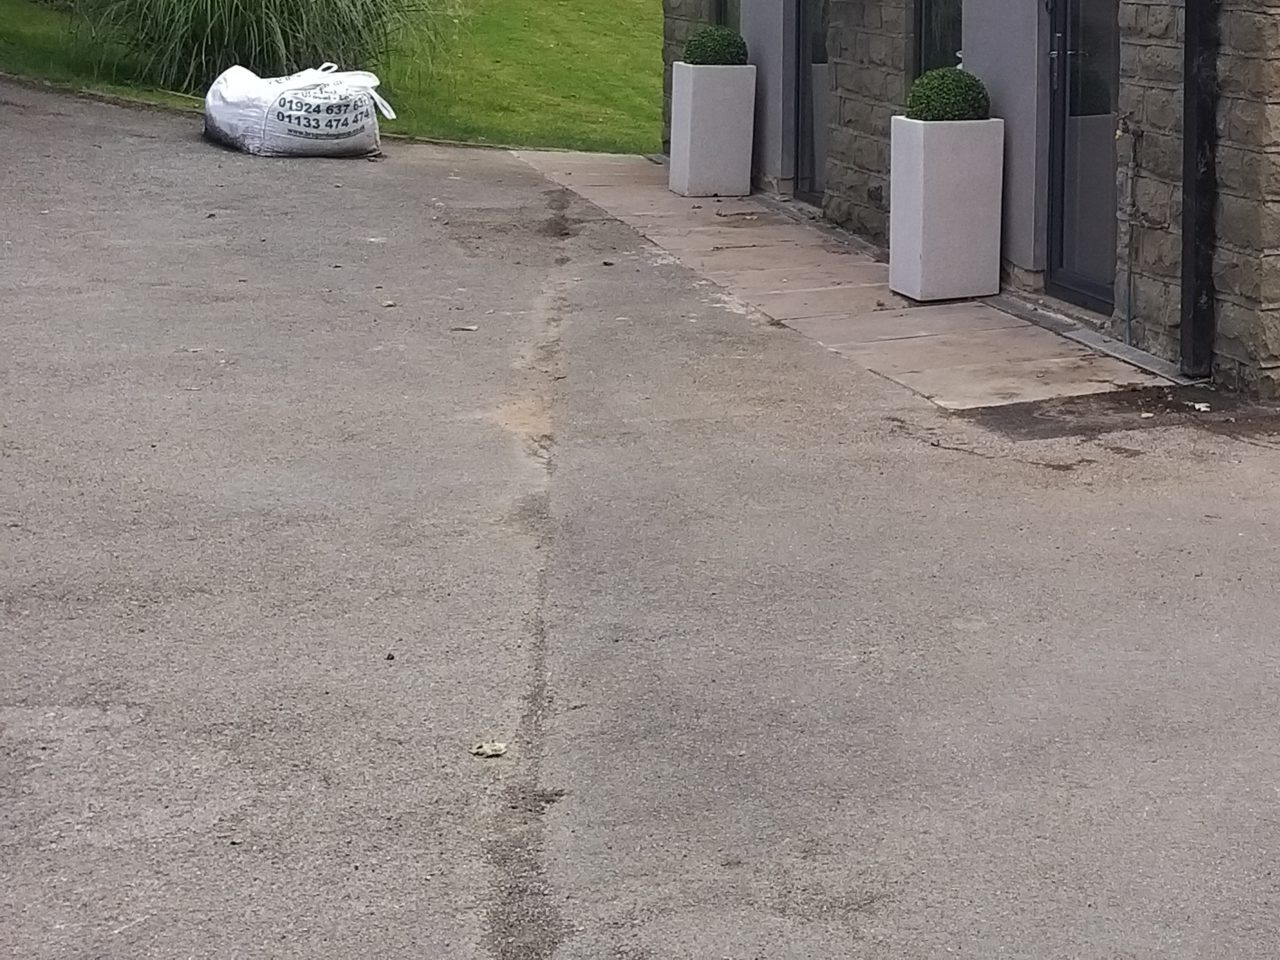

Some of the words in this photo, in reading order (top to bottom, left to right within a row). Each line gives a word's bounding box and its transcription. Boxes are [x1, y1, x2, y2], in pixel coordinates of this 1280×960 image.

[278, 97, 321, 114] 01924
[325, 104, 350, 115] 637
[277, 111, 320, 129] 01133
[325, 117, 349, 129] 474
[352, 108, 369, 124] 474
